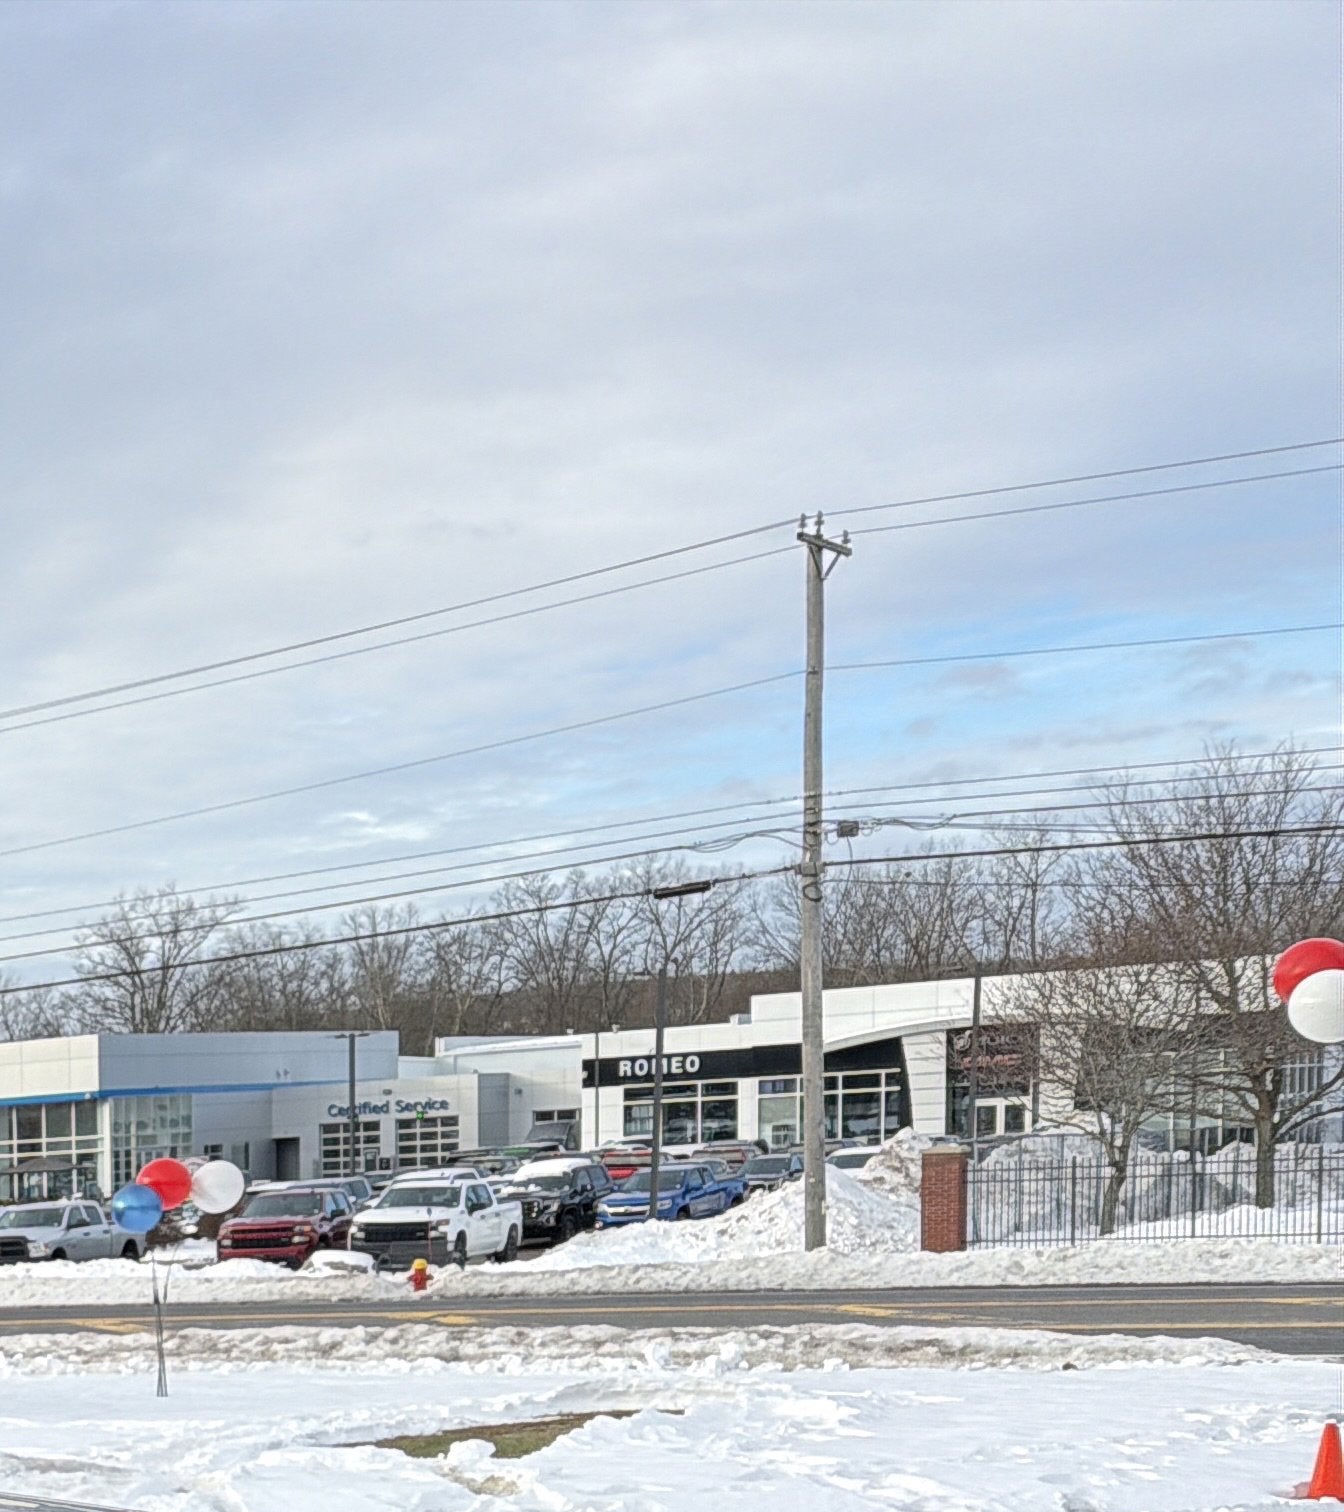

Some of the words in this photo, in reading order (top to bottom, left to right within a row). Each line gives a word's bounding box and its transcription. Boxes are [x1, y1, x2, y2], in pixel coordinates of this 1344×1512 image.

[618, 1055, 700, 1077] ROMEO
[327, 1100, 390, 1118] Cerified
[395, 1097, 450, 1114] Service
